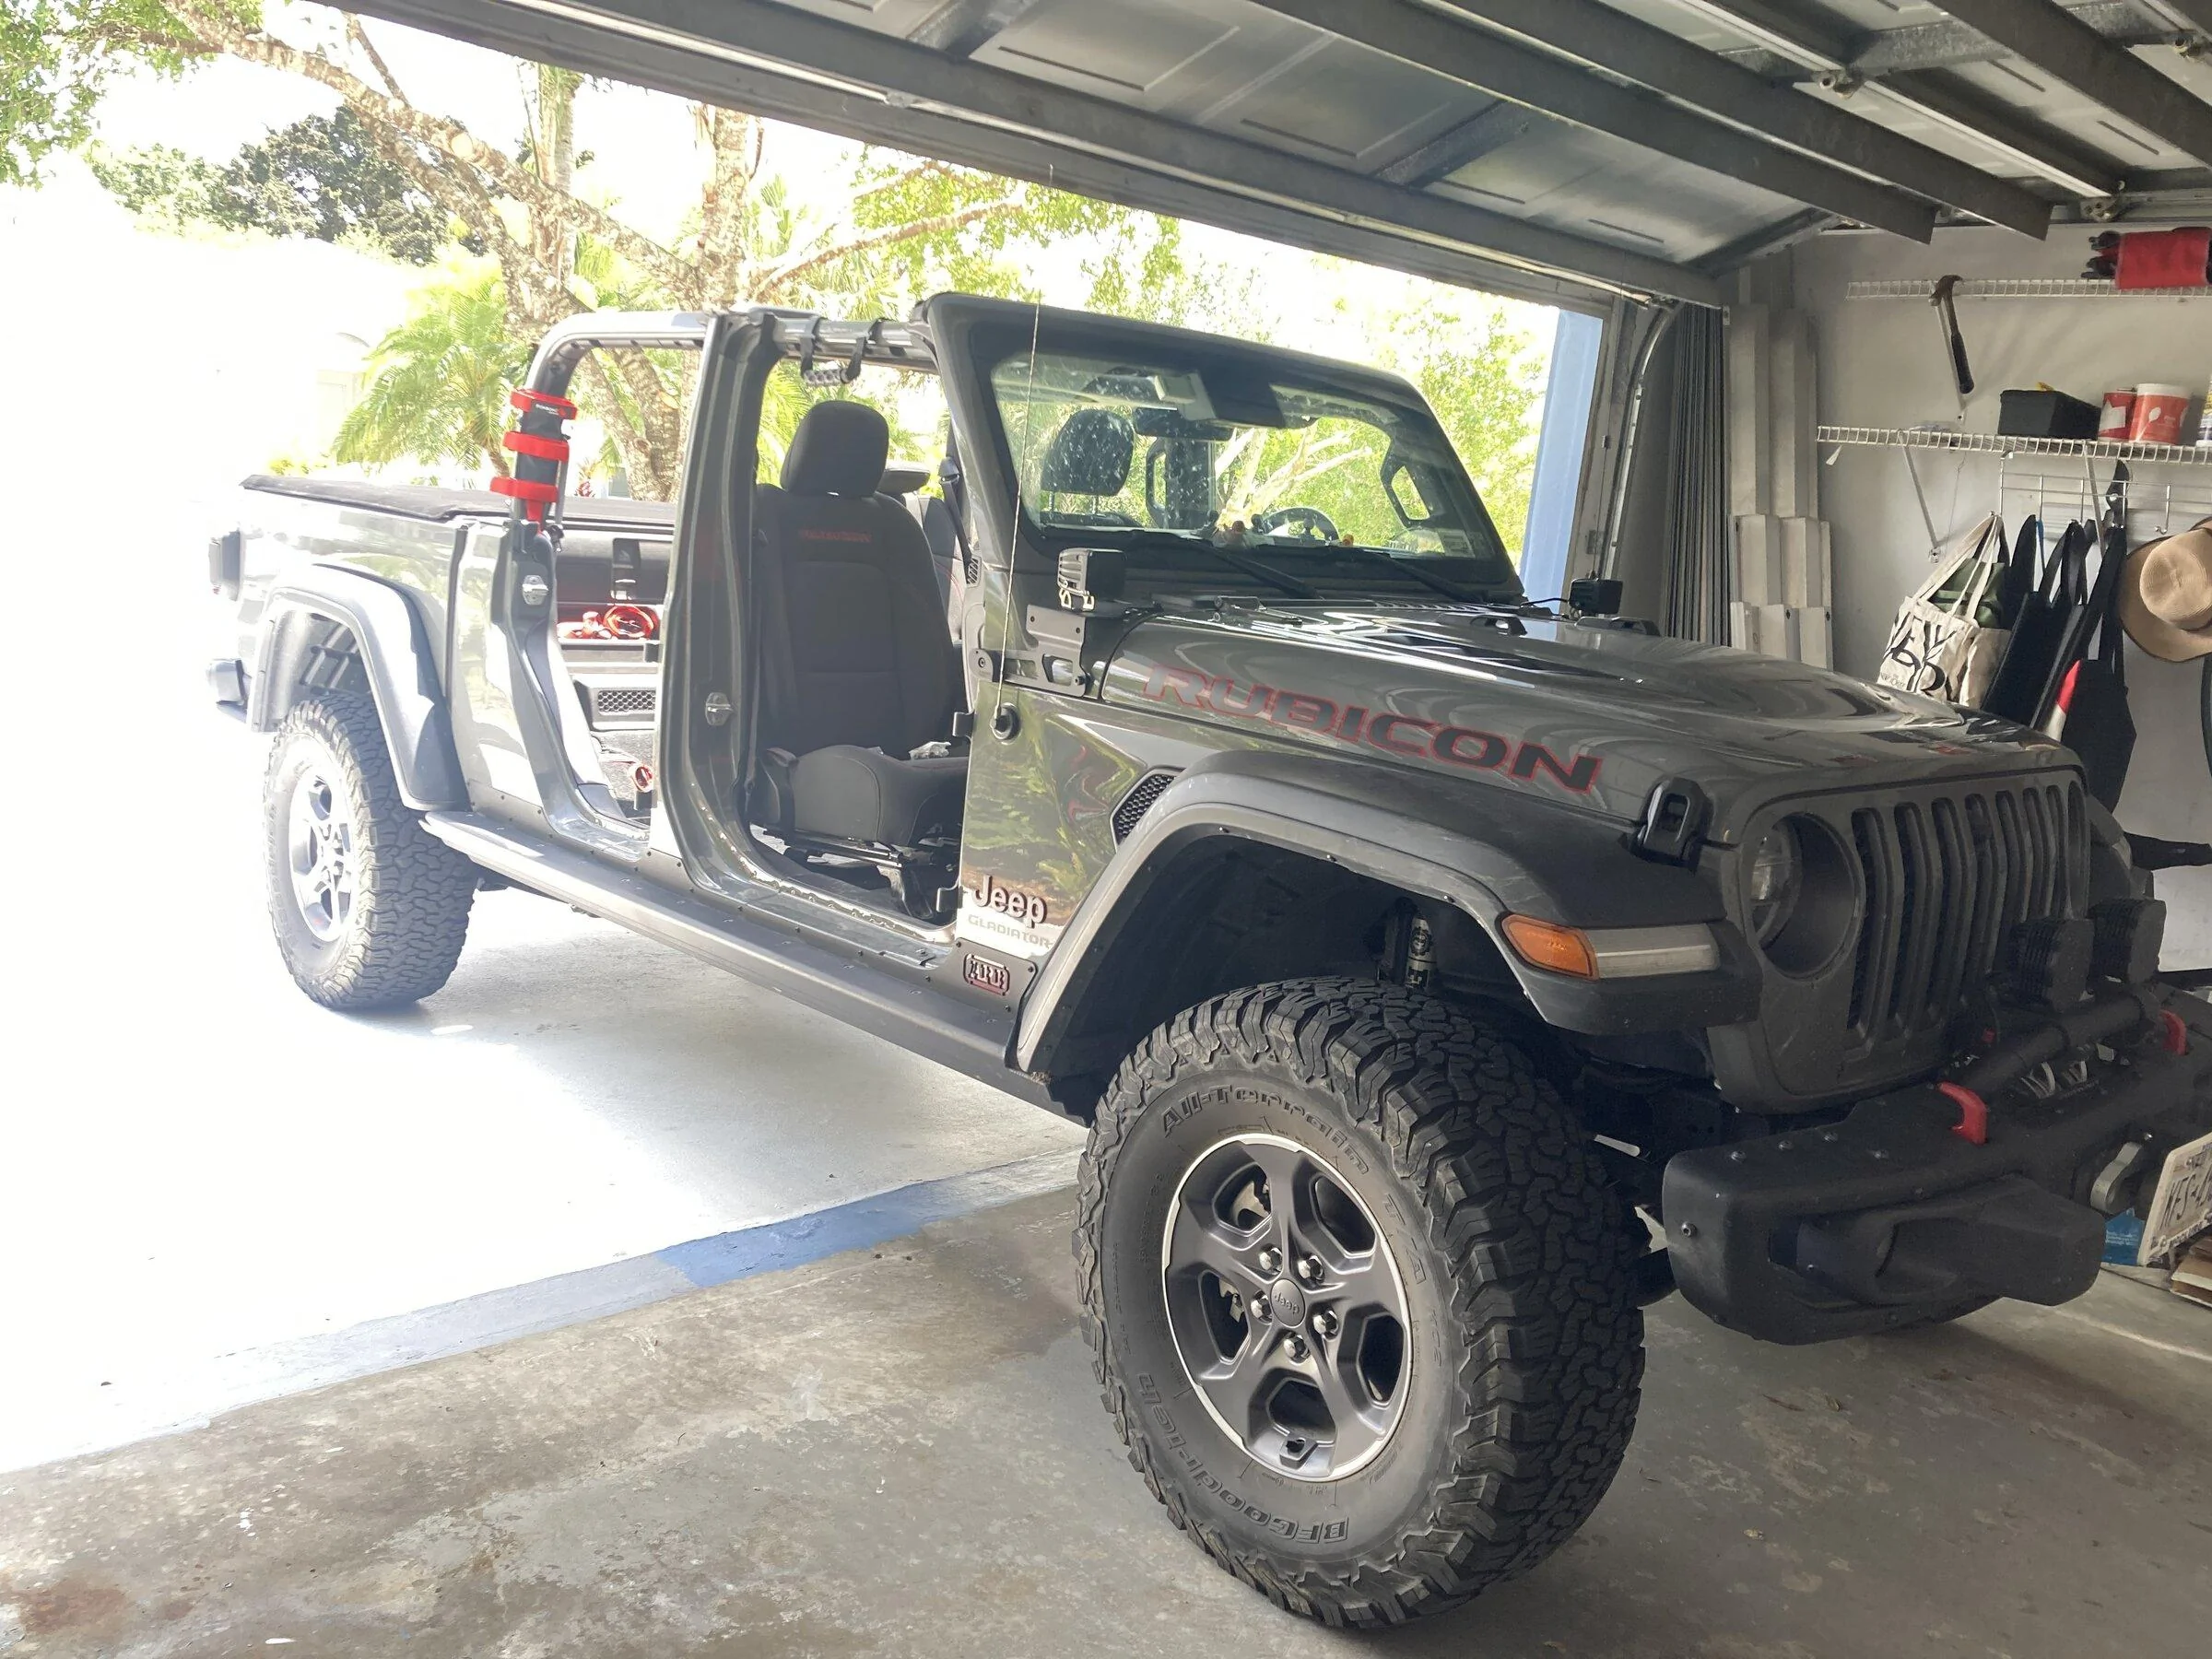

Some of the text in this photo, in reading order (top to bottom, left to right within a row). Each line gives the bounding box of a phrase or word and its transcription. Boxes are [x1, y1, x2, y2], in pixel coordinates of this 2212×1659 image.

[1142, 663, 1603, 794] RUBICON
[972, 875, 1048, 929] Jeep
[968, 913, 1055, 949] GLADIATOR
[1162, 1084, 1370, 1175] All-Terrain
[1274, 1292, 1300, 1315] Jeep
